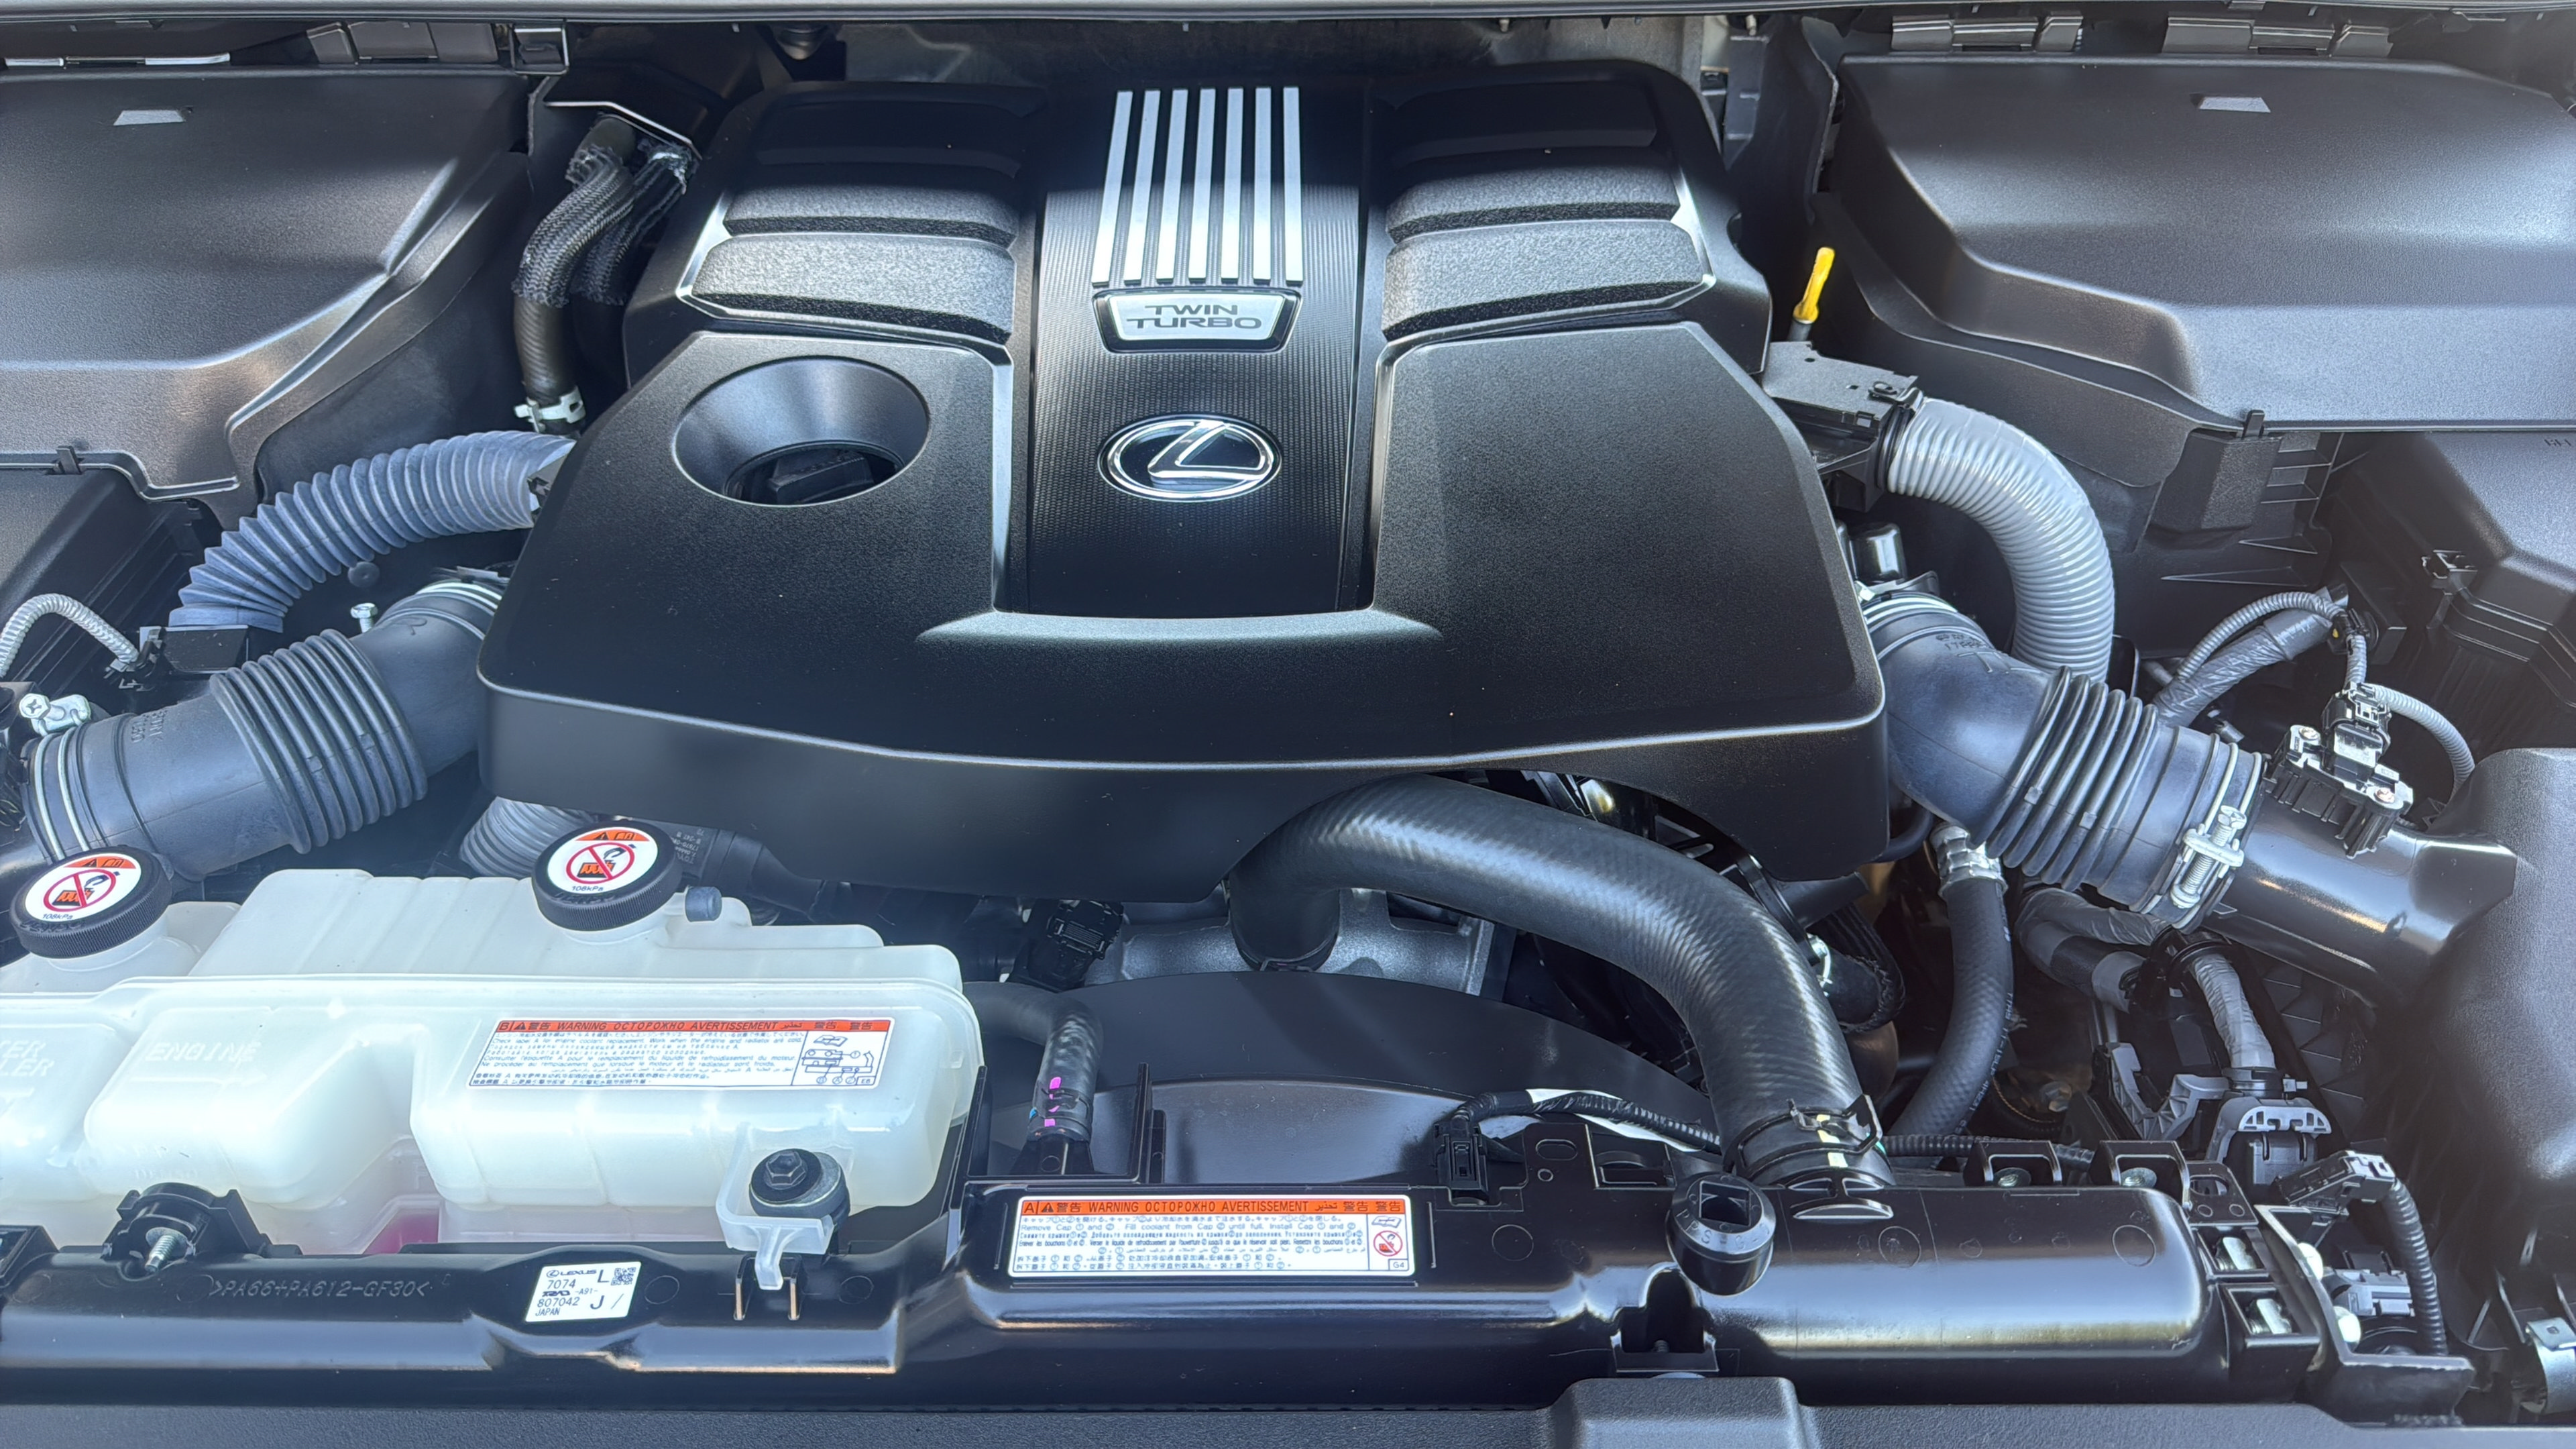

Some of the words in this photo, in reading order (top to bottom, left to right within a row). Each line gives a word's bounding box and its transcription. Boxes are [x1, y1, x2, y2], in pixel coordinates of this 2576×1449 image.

[1145, 305, 1238, 315] TWIN
[1126, 317, 1262, 329] TURBO
[499, 1022, 509, 1030] B
[528, 1022, 551, 1030] 警告
[557, 1022, 608, 1030] WARNING
[613, 1022, 686, 1030] ОСТОРОЖНО
[690, 1022, 778, 1030] AVERTISSEMENT
[1023, 1203, 1035, 1214] A
[1057, 1202, 1081, 1213] 警告
[1088, 1201, 1139, 1212] WARNING
[1145, 1201, 1216, 1212] ОСТОРОЖНО
[1221, 1201, 1309, 1212] AVERTISSEMENT
[1315, 1201, 1338, 1211] تحذير
[1343, 1201, 1368, 1212] 警告
[1376, 1201, 1401, 1212] 警告
[597, 1269, 610, 1283] L
[547, 1279, 577, 1289] 7074
[537, 1296, 581, 1308] 807042
[590, 1295, 605, 1309] J
[535, 1308, 561, 1316] JAPAN
